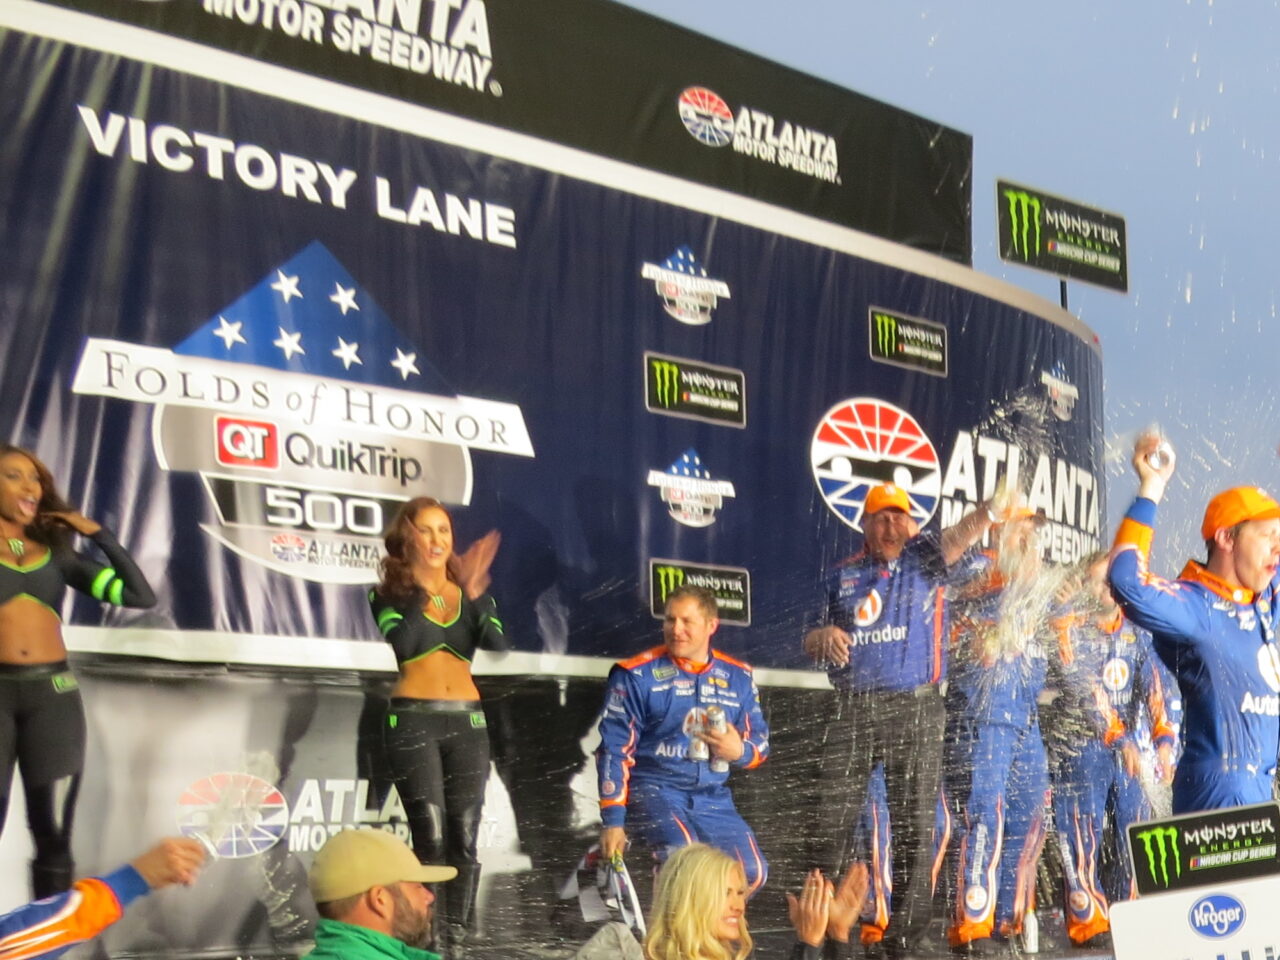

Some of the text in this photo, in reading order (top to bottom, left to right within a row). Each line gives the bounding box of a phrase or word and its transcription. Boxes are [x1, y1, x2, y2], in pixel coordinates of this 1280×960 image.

[331, 12, 493, 93] SPEEDWAY
[734, 105, 839, 167] ATLANTA
[76, 104, 517, 248] VICTORY LANE
[732, 134, 838, 184] MOTOR SPEEDWAY
[1045, 207, 1120, 248] MONSTER
[100, 350, 510, 447] FOLDS of HONOR
[681, 370, 740, 396] MONSTER
[222, 423, 422, 487] QT QuikTrip
[941, 429, 1100, 539] ATLANTA
[265, 487, 383, 535] 500
[308, 539, 381, 560] ATLANTA
[686, 573, 744, 594] MONSTER
[289, 778, 410, 823] ATLA
[1183, 817, 1276, 846] MONSTER
[1200, 836, 1263, 854] ENERGY
[1199, 851, 1232, 868] NASCAR
[1232, 849, 1249, 863] CUP
[1193, 900, 1243, 936] Kroger
